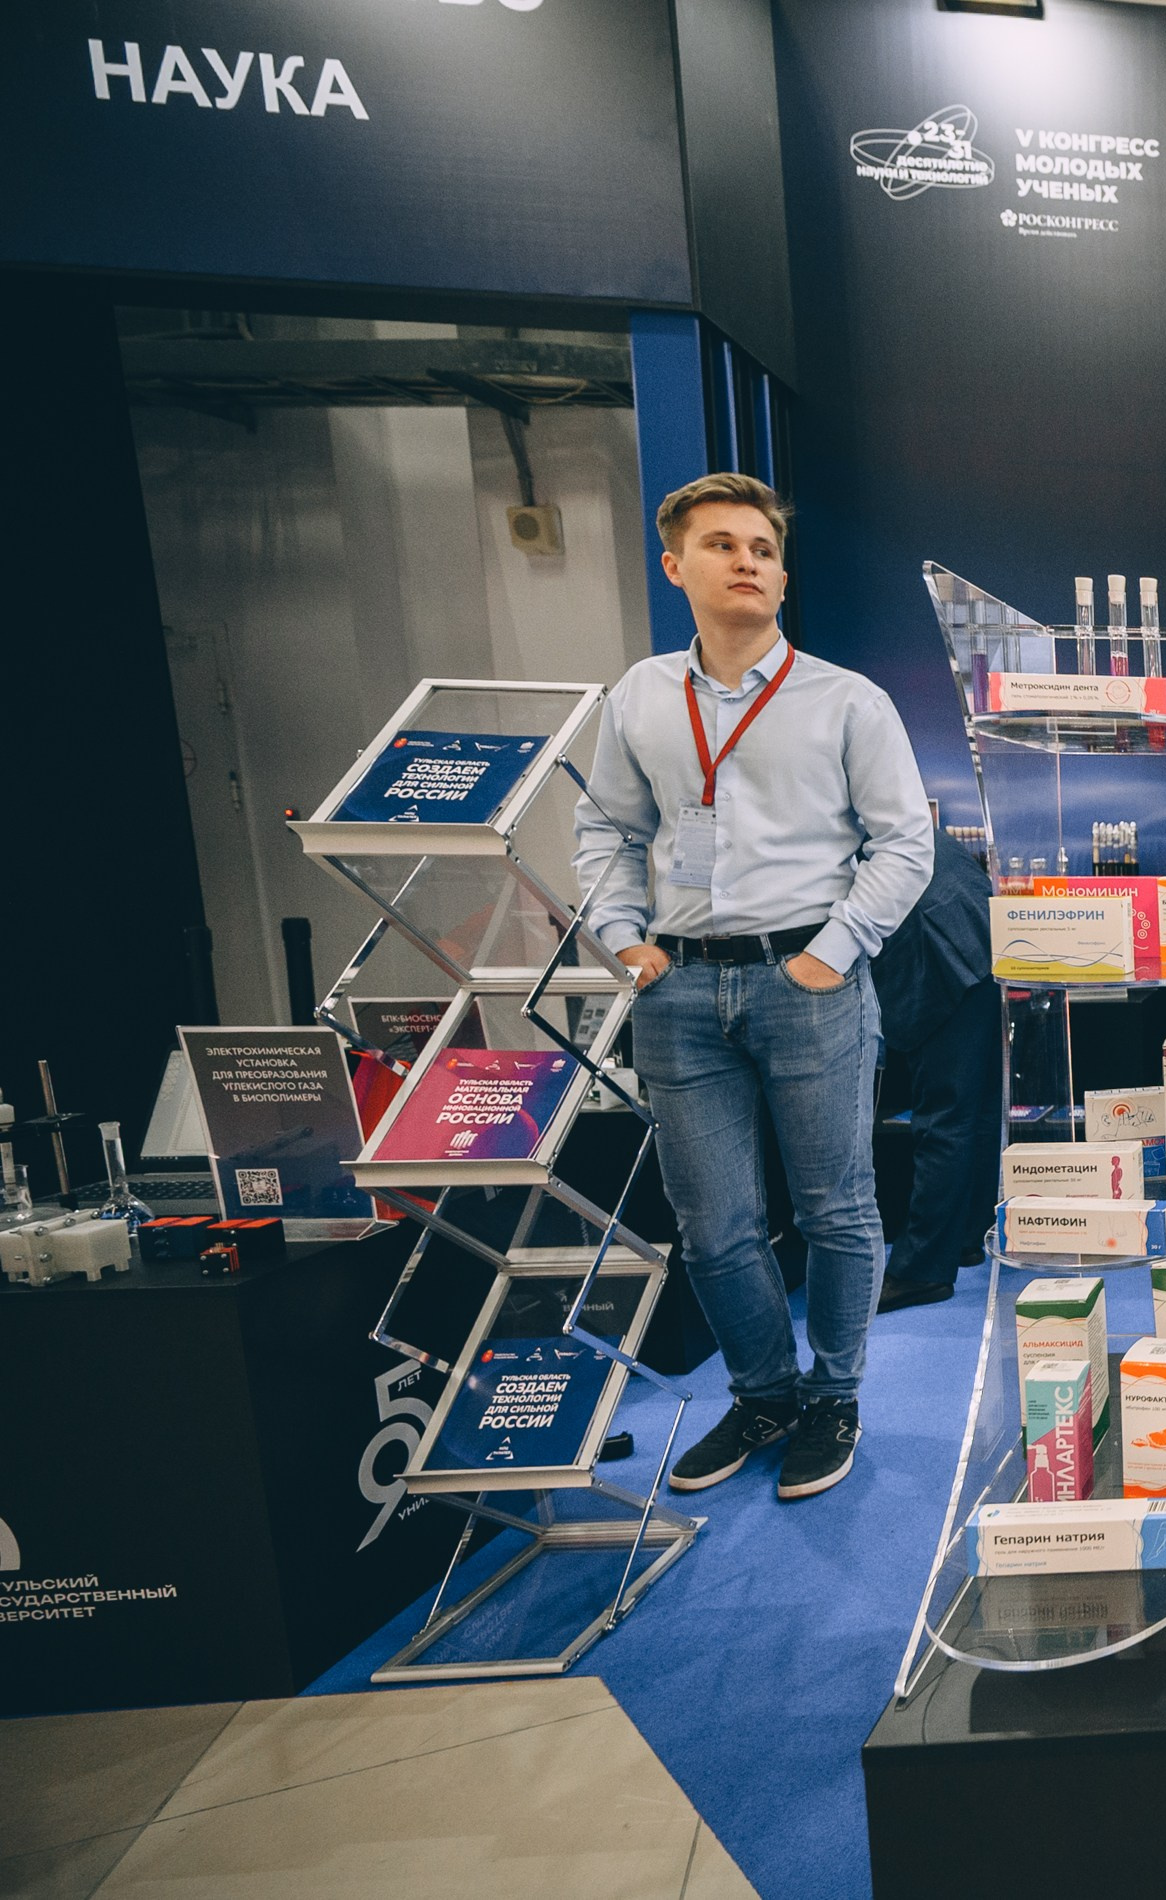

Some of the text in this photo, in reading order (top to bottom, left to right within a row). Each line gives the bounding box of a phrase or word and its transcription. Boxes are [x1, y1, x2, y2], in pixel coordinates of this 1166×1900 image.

[88, 38, 370, 120] НАУКА
[1015, 128, 1161, 158] V КОНГРЕСС
[1014, 153, 1144, 181] МОЛОДЫХ
[1015, 178, 1119, 204] УЧЕНЫХ
[1018, 212, 1120, 233] РОСКОНГРЕСС
[1010, 681, 1099, 693] Метроксидин дента
[413, 757, 490, 767] ТУЛЬСКАЯ ОБЛАСТЬ
[406, 763, 487, 776] СОЗДАЕМ
[401, 772, 479, 783] ТЕХНОЛОГИИ
[392, 780, 475, 790] ДЛЯ СИЛЬНОЙ
[384, 788, 469, 801] РОССИИ
[1041, 885, 1139, 897] Мономицин
[1007, 910, 1105, 921] ФЕНИЛЭФРИН
[206, 1047, 322, 1056] ЭЛЕКТРОХИМИЧЕСКАЯ
[236, 1059, 298, 1067] УСТАНОВКА
[212, 1070, 328, 1080] ДЛЯ ПРЕОБРАЗОВАНИЯ
[222, 1082, 324, 1091] УГЛЕКИСЛОГО ГАЗА
[454, 1086, 529, 1094] МАТЕРИАЛЬНАЯ
[233, 1093, 322, 1102] В БИОПОЛИМЕРЫ
[448, 1094, 523, 1105] ОСНОВА
[442, 1103, 521, 1112] ИННОВАЦИОННОЙ
[436, 1112, 515, 1124] РОССИИ
[1012, 1165, 1098, 1175] Индометацин
[1018, 1216, 1087, 1227] НАФТИФИН
[397, 1370, 423, 1392] ЛЕТ
[496, 1381, 567, 1393] СОЗДАЕМ
[492, 1393, 562, 1403] ТЕХНОЛОГИИ
[484, 1402, 558, 1415] ДЛЯ СИЛЬНОЙ
[479, 1414, 553, 1430] РОССИИ
[993, 1532, 1105, 1546] Гепарин натрия
[0, 1574, 99, 1592] УЛЬСКИЙ
